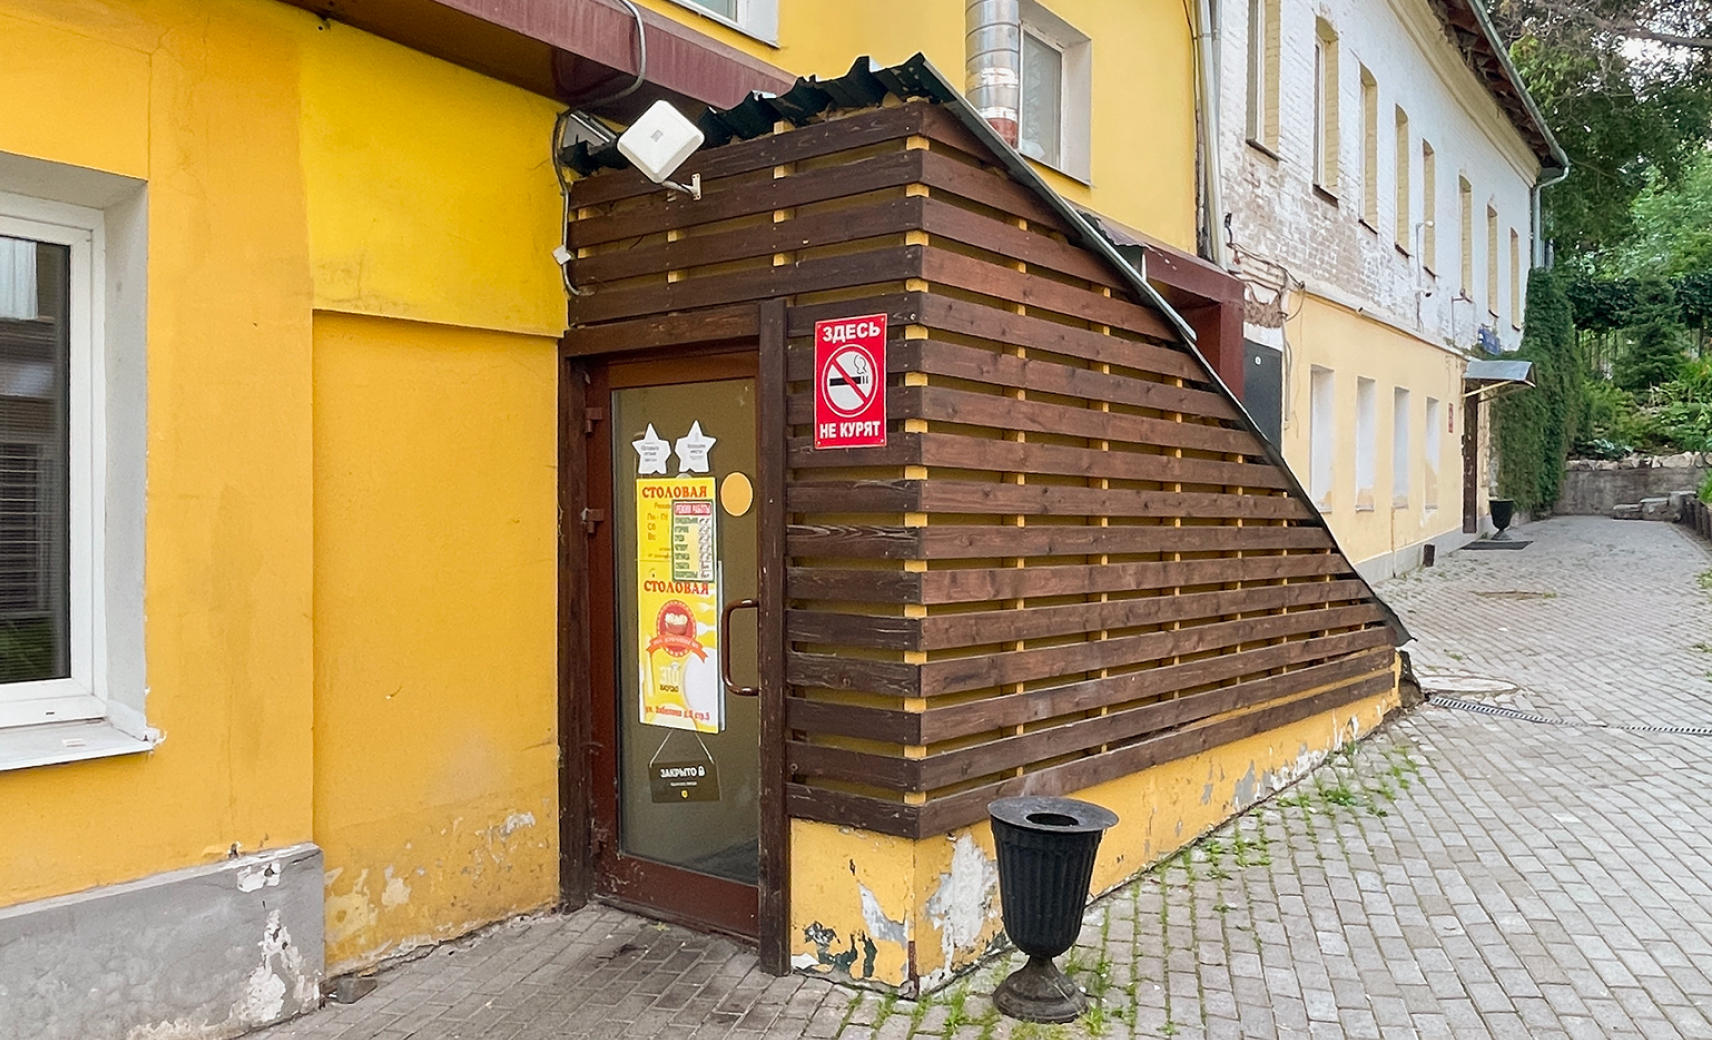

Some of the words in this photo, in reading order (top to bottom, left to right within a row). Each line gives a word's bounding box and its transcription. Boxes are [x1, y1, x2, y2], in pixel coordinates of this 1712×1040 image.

[823, 322, 881, 344] ЗДЕСЬ
[820, 423, 837, 439] НЕ
[840, 421, 881, 438] КУРЯТ
[641, 486, 708, 499] СТОЛОВАЯ
[644, 581, 709, 595] СТОЛОВАЯ
[660, 767, 698, 778] ЗАКРЫТО
